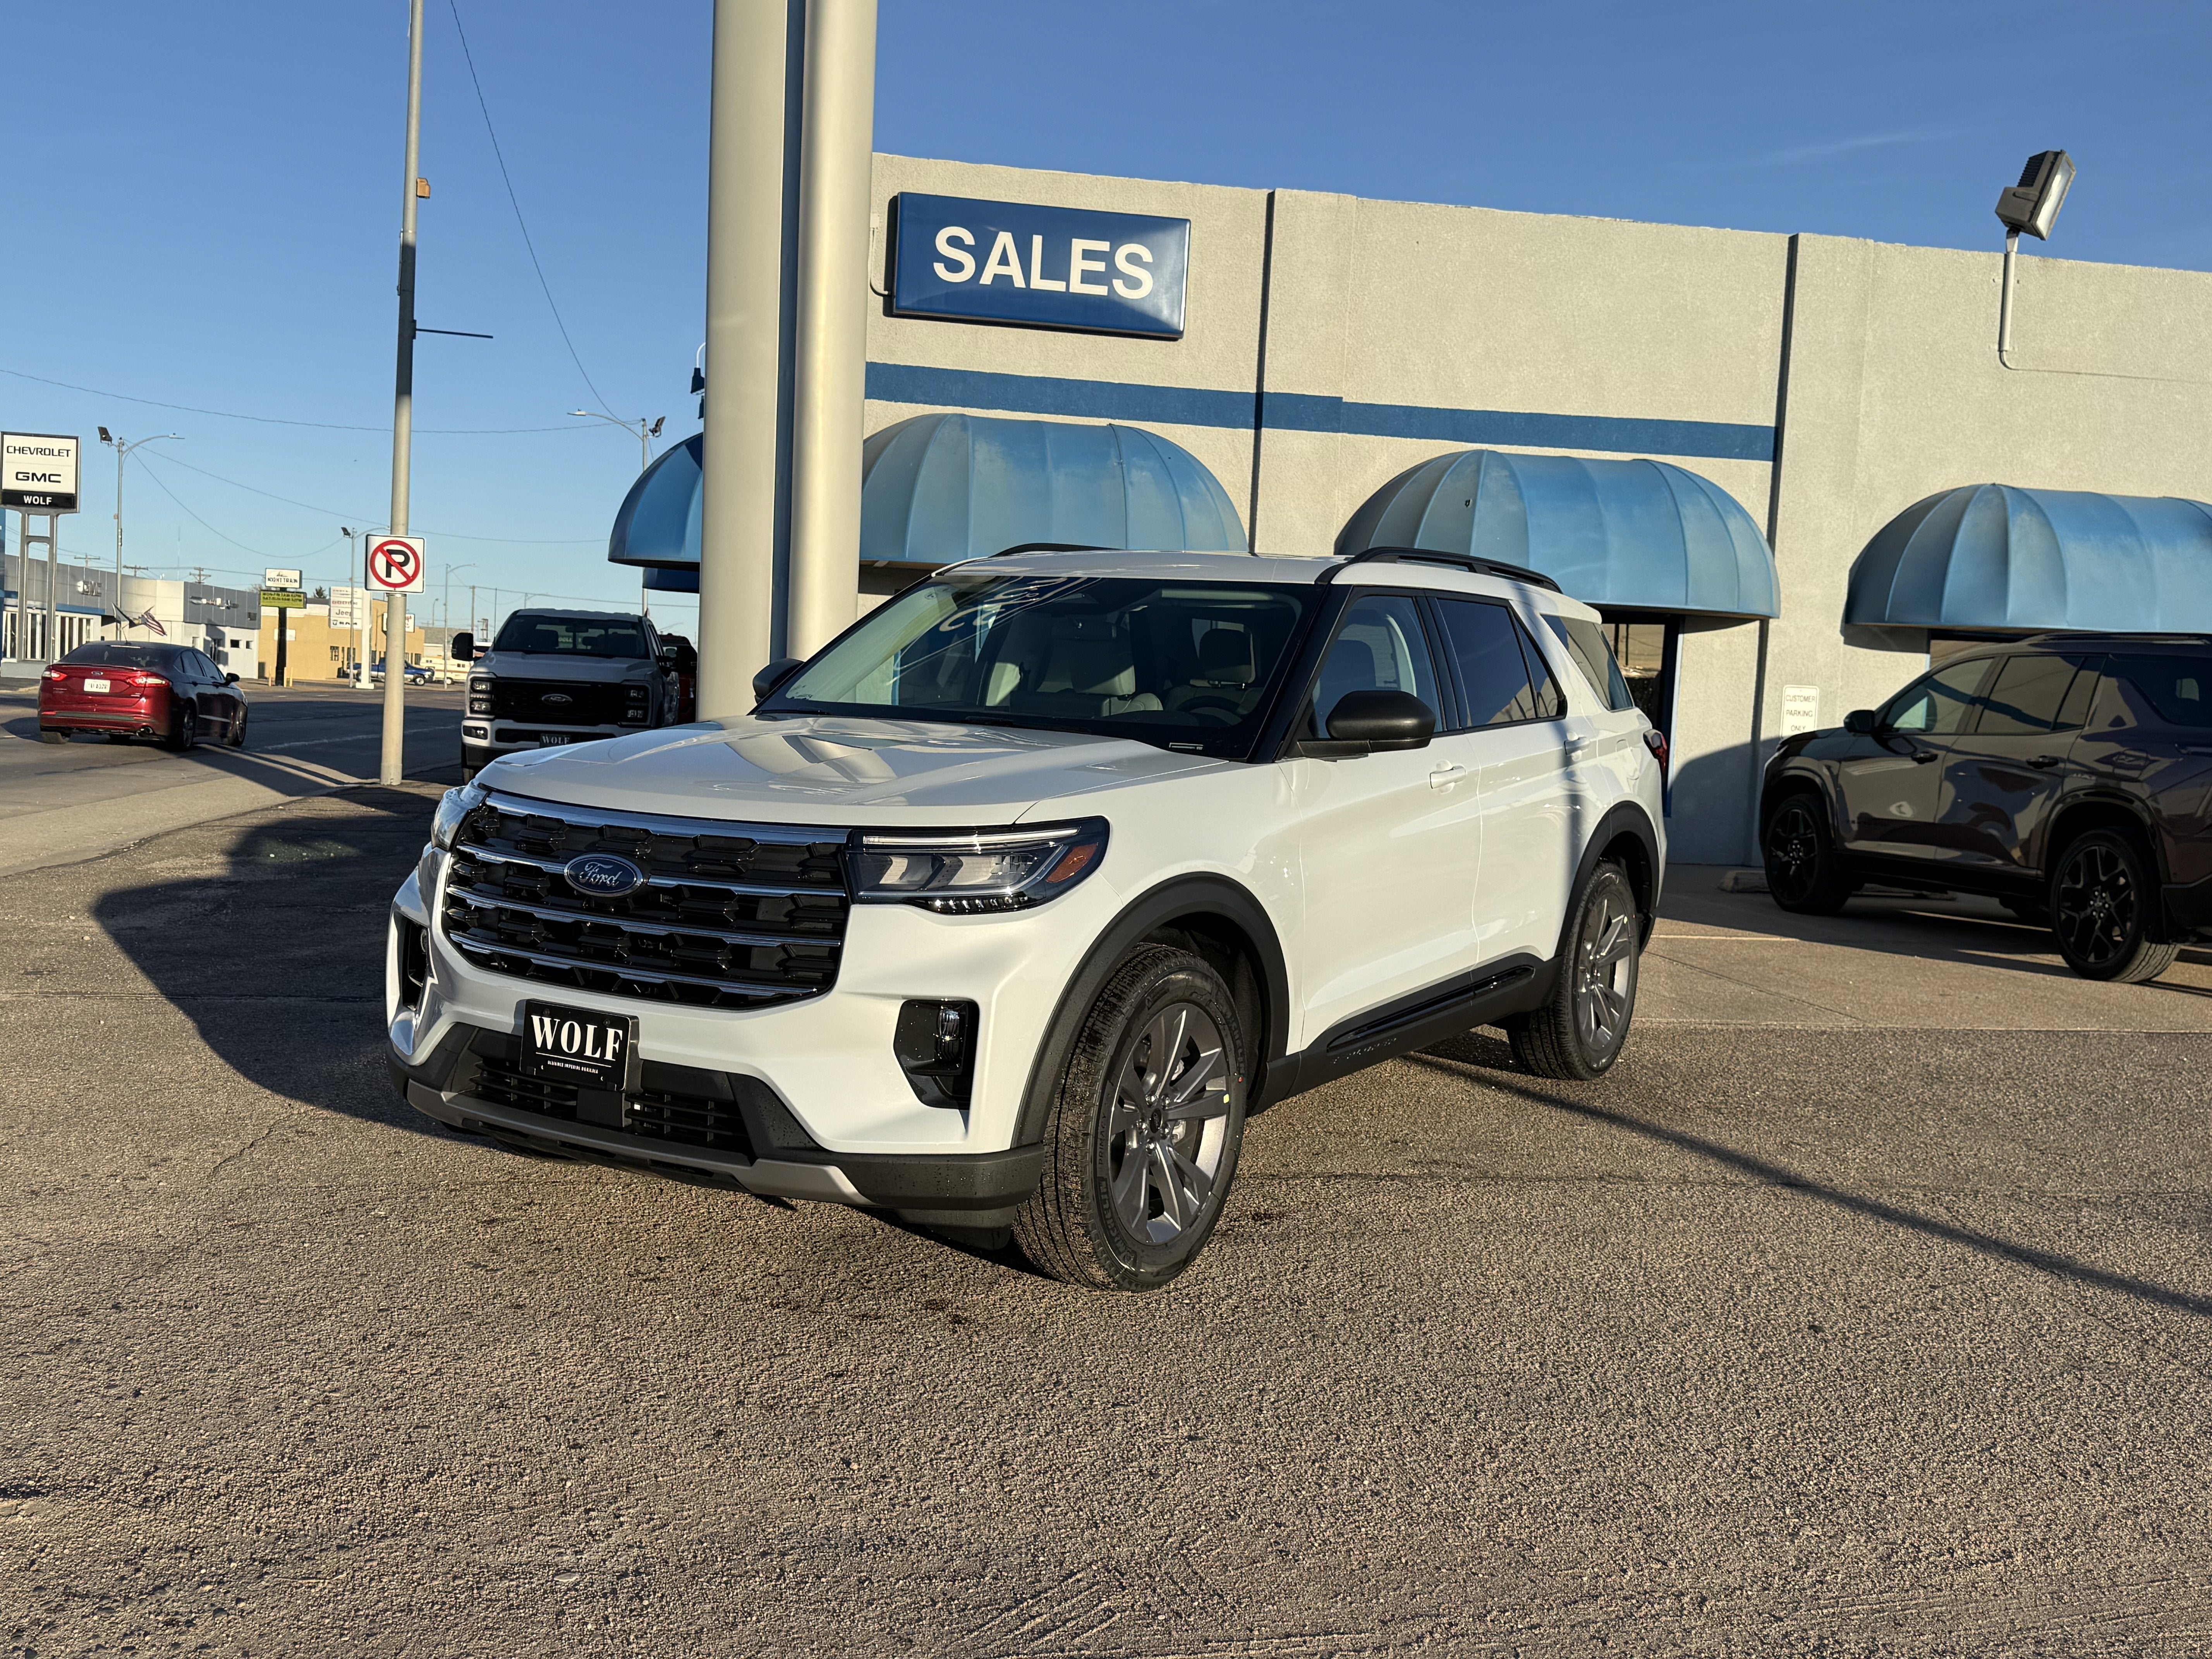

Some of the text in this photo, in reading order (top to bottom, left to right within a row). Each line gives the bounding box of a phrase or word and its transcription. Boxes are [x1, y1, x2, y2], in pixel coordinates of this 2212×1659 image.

[934, 227, 1153, 299] SALES
[7, 446, 71, 457] CHEVROLET
[15, 472, 61, 483] GMC
[24, 495, 52, 505] WOLF
[542, 735, 570, 744] WOLF
[579, 862, 622, 887] Ford
[531, 1015, 623, 1061] WOLF
[1100, 1180, 1126, 1253] MICHELIN
